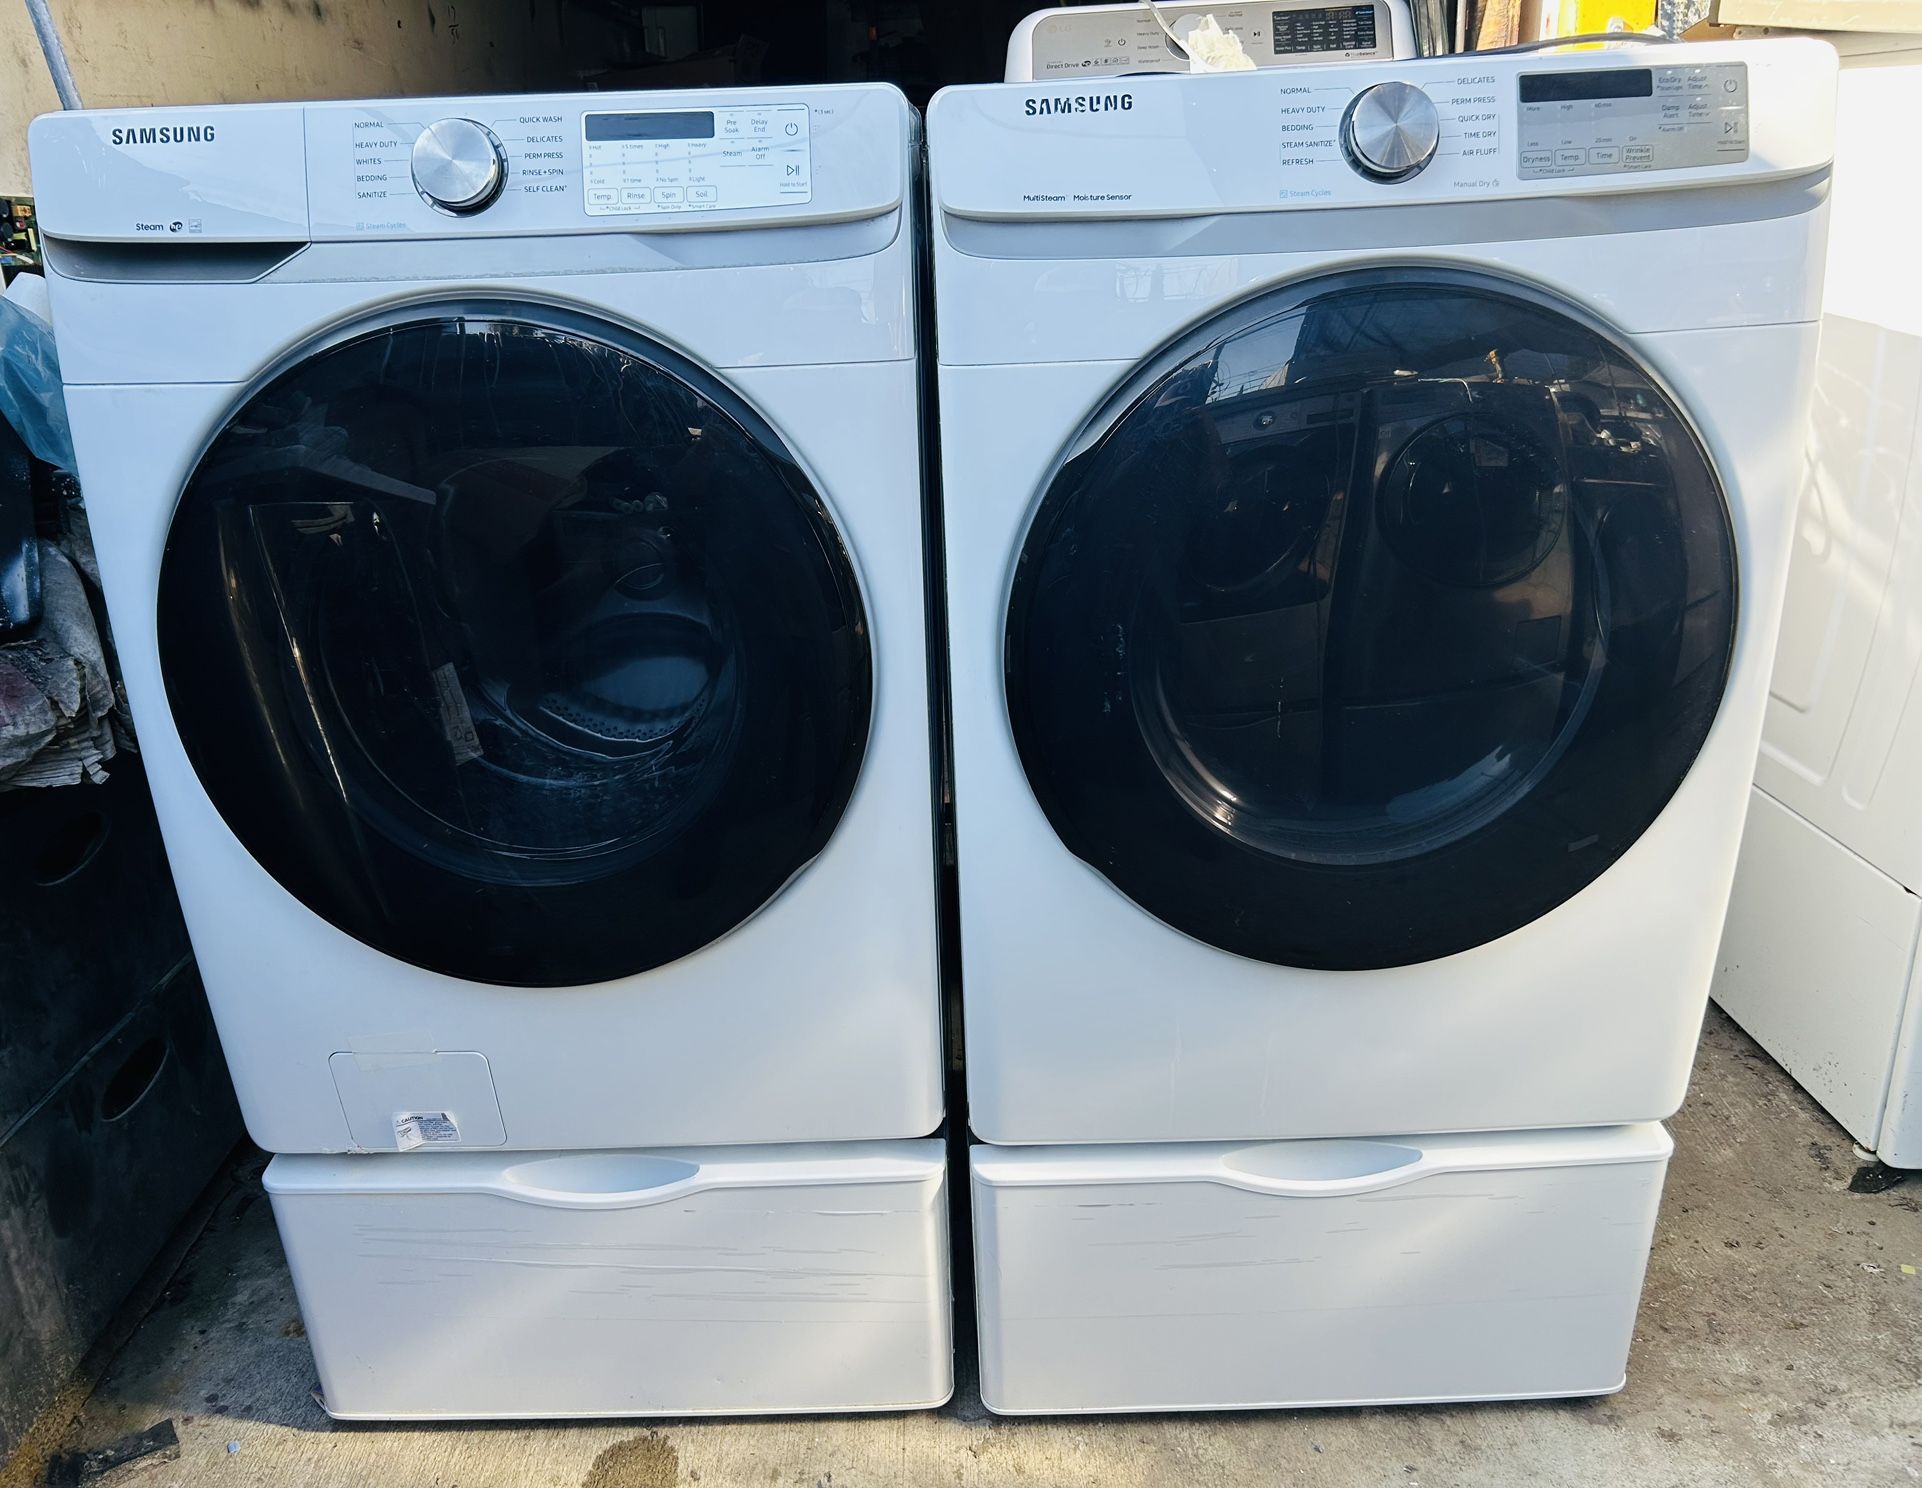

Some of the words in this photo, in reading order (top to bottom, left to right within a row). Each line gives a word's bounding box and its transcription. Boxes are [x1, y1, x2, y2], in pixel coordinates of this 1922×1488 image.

[1457, 76, 1495, 85] DELICATES
[1025, 94, 1133, 116] SAMSUNG
[112, 126, 215, 145] SAMSUNG
[1523, 156, 1550, 164] Dryness
[358, 191, 387, 199] SANITIZE
[1311, 190, 1331, 198] Cycles
[136, 223, 164, 231] Steam
